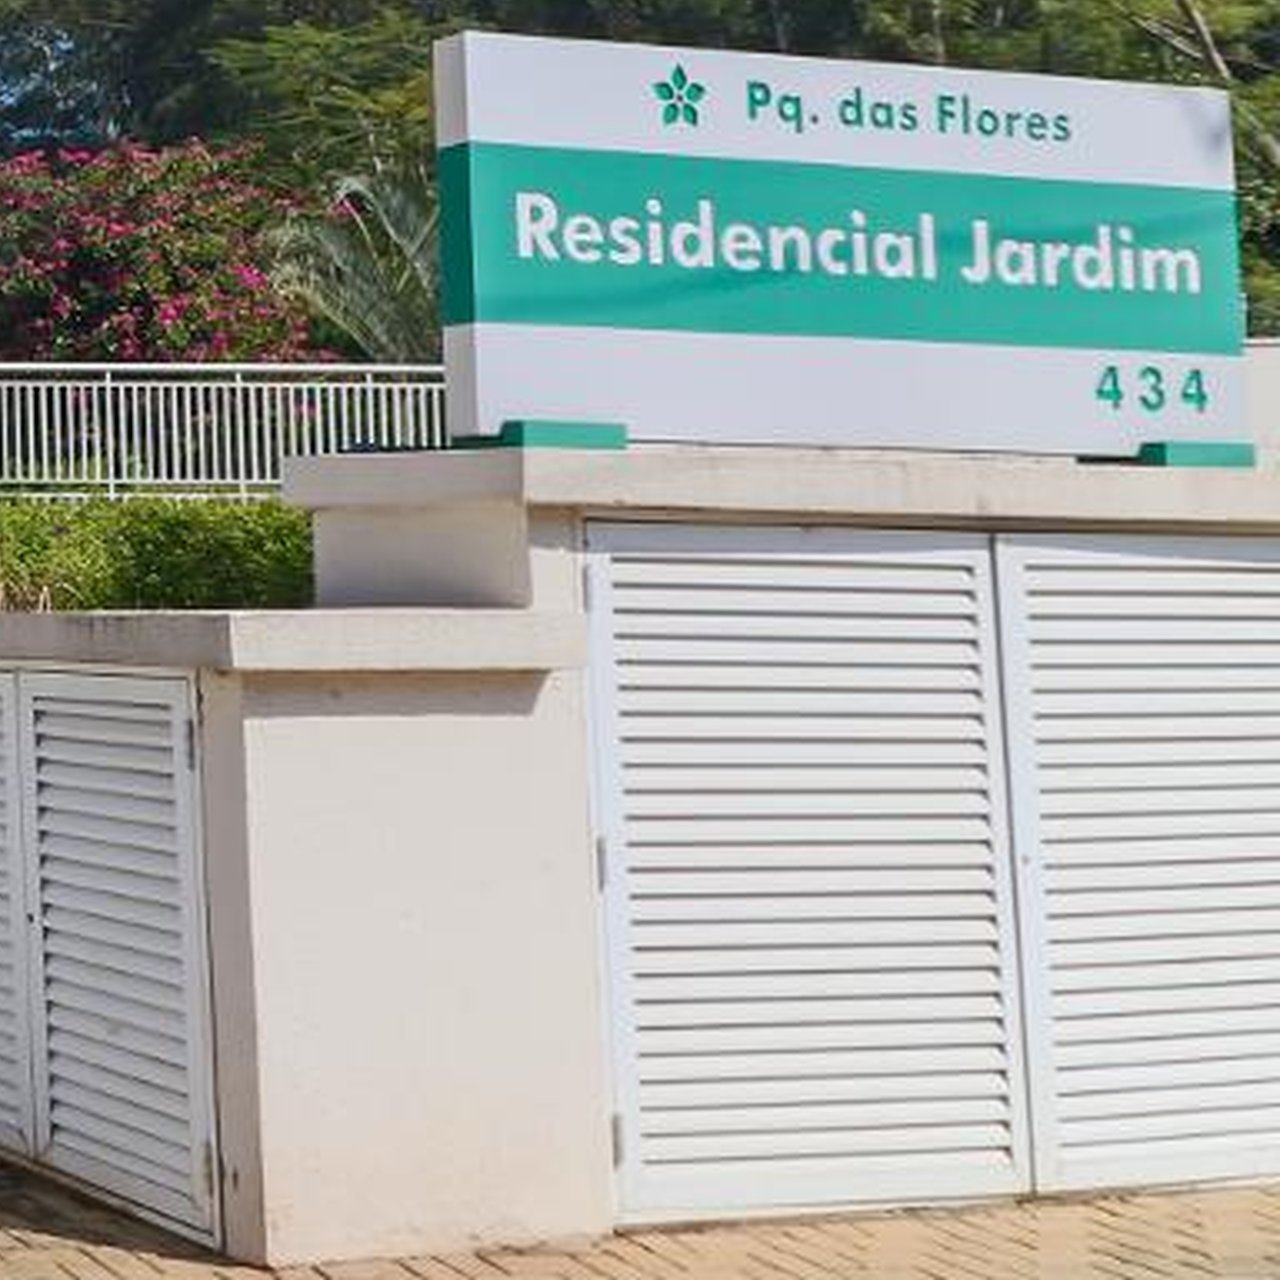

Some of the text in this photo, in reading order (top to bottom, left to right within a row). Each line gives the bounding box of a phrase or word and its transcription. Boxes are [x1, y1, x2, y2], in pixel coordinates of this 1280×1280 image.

[745, 80, 1073, 141] Pq. das Flores
[514, 191, 1203, 295] Residencial Jardim
[1093, 365, 1210, 413] 434
